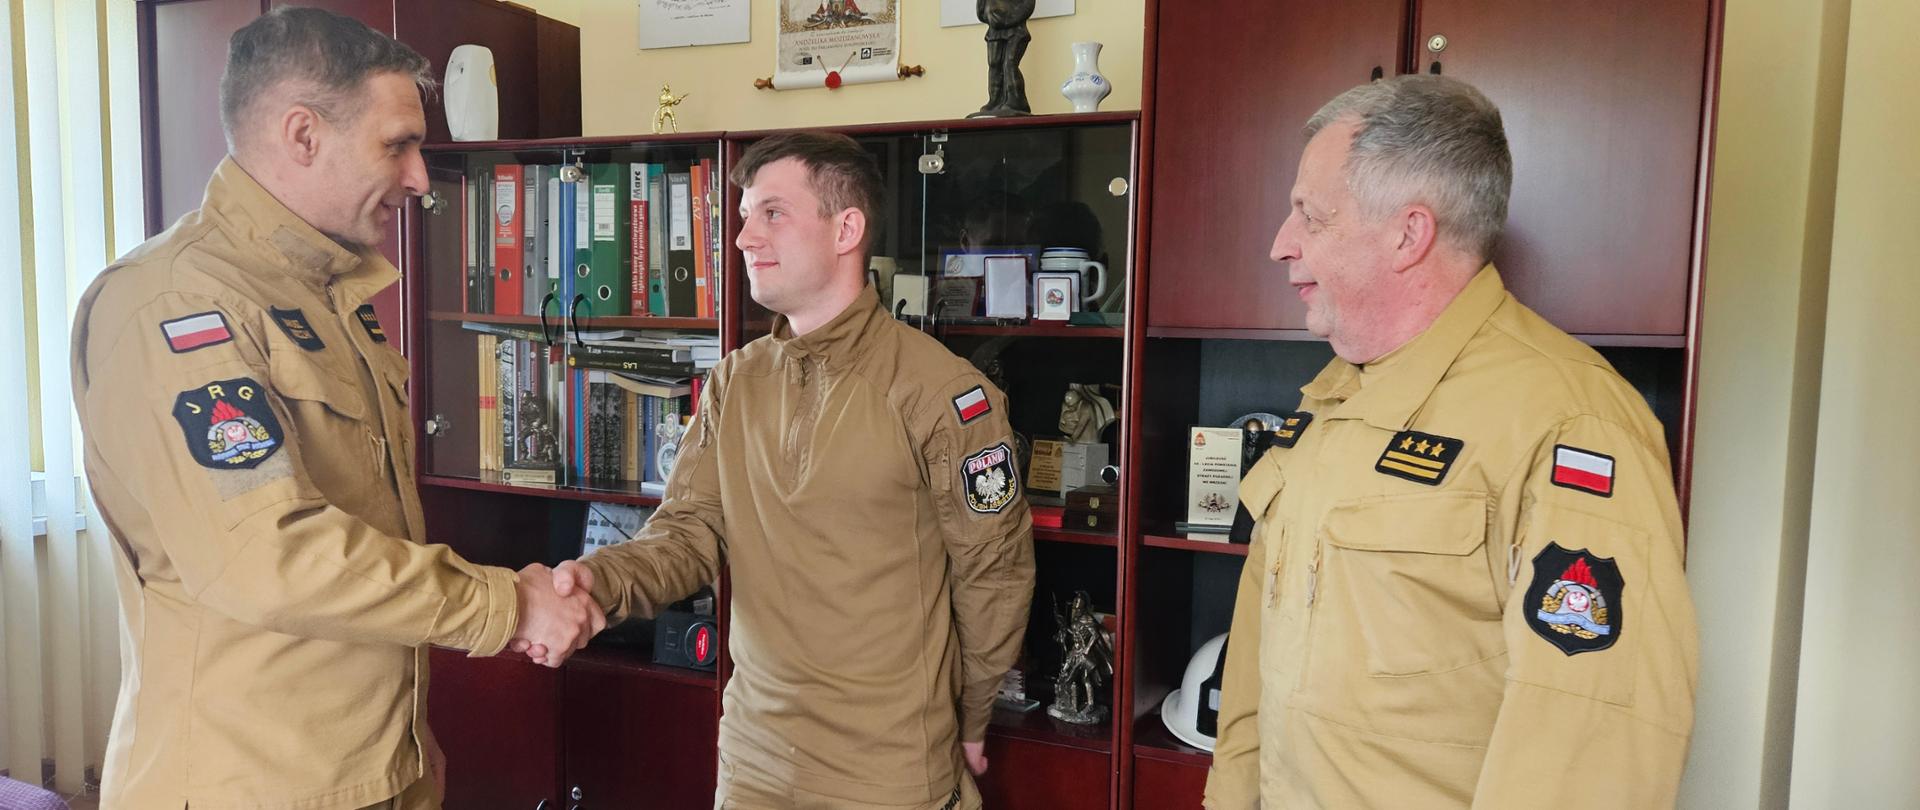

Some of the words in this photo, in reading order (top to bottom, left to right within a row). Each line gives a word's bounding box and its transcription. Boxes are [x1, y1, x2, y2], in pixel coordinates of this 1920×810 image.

[632, 170, 641, 199] Marc
[693, 196, 702, 220] GAZ
[623, 361, 638, 369] LAS
[968, 449, 1005, 474] POLAND
